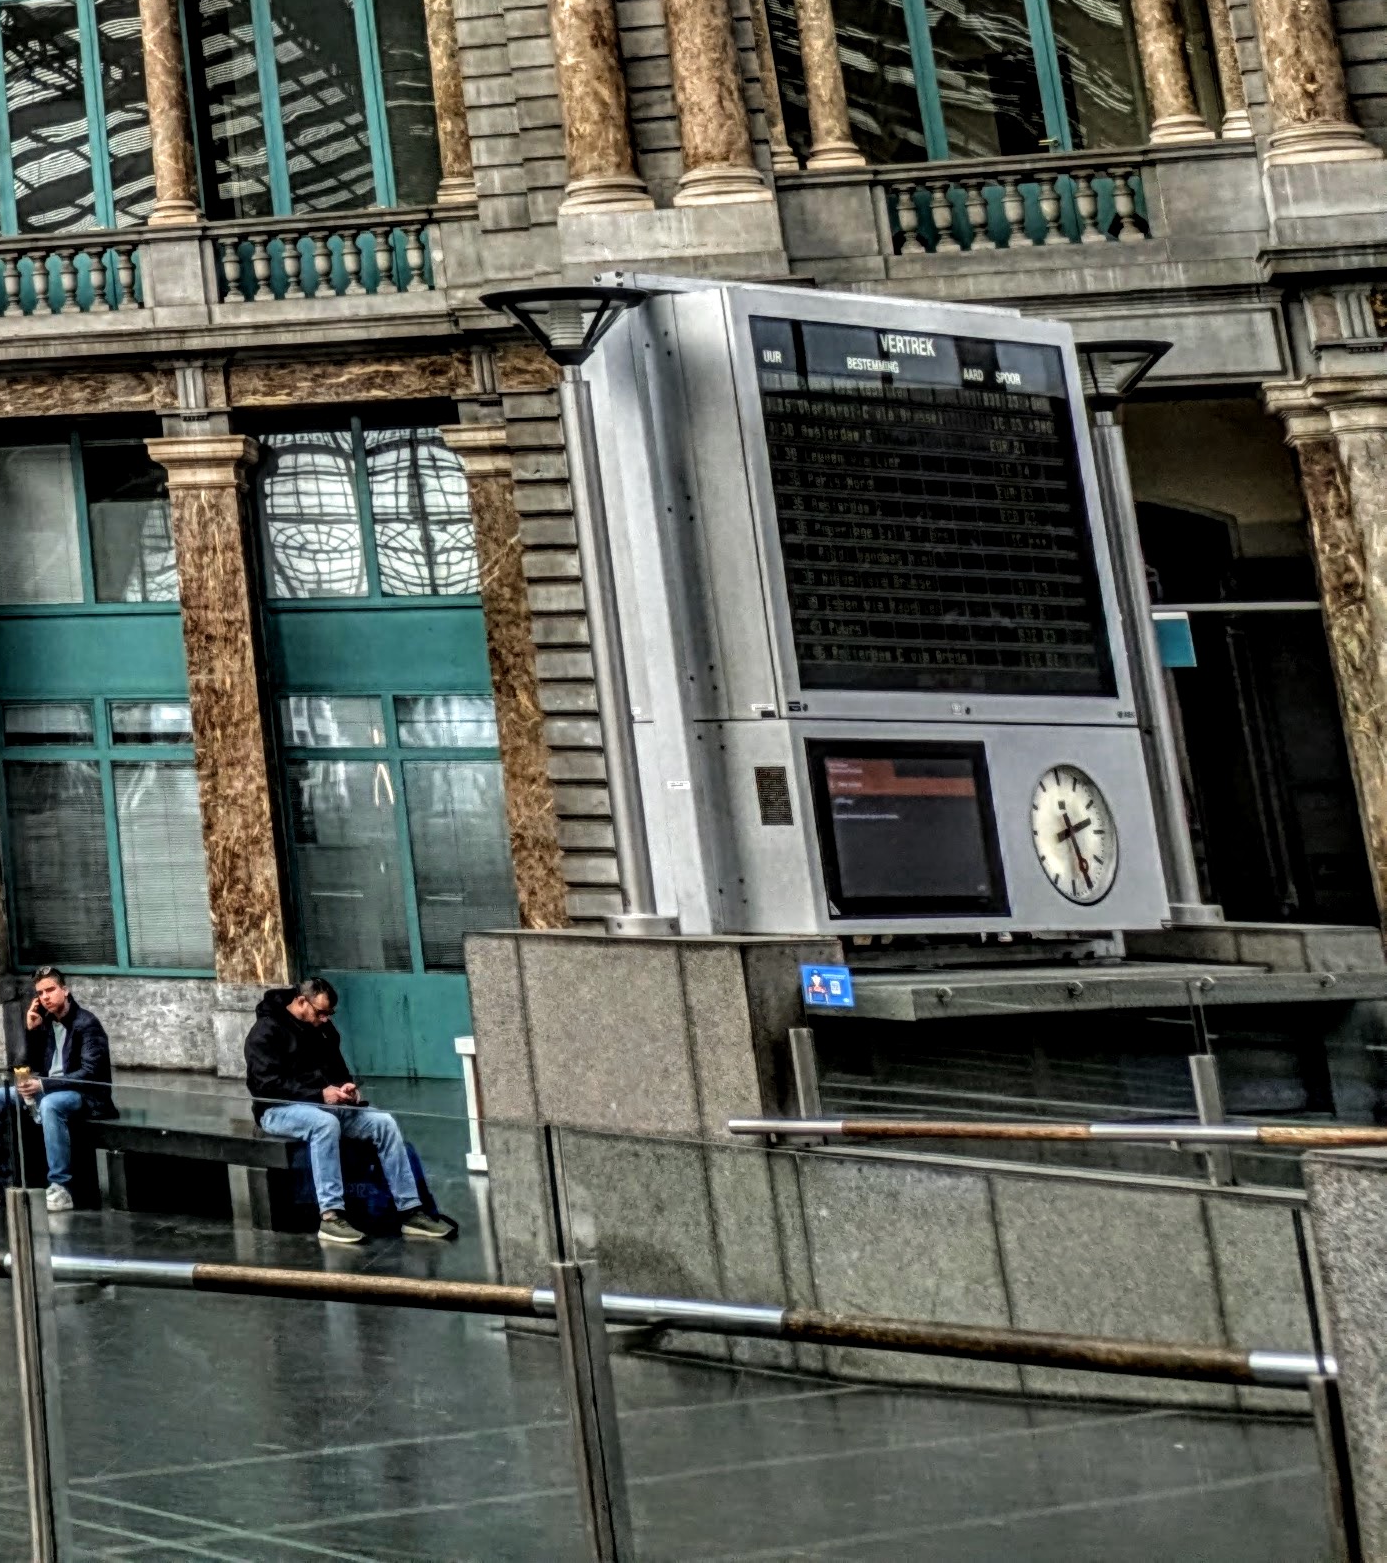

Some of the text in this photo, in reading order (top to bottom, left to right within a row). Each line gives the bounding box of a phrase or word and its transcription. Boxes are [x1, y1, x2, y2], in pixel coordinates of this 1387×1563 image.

[879, 334, 937, 358] VERTREK
[763, 350, 1022, 386] UUR BESTEMMING AARD SPOOR
